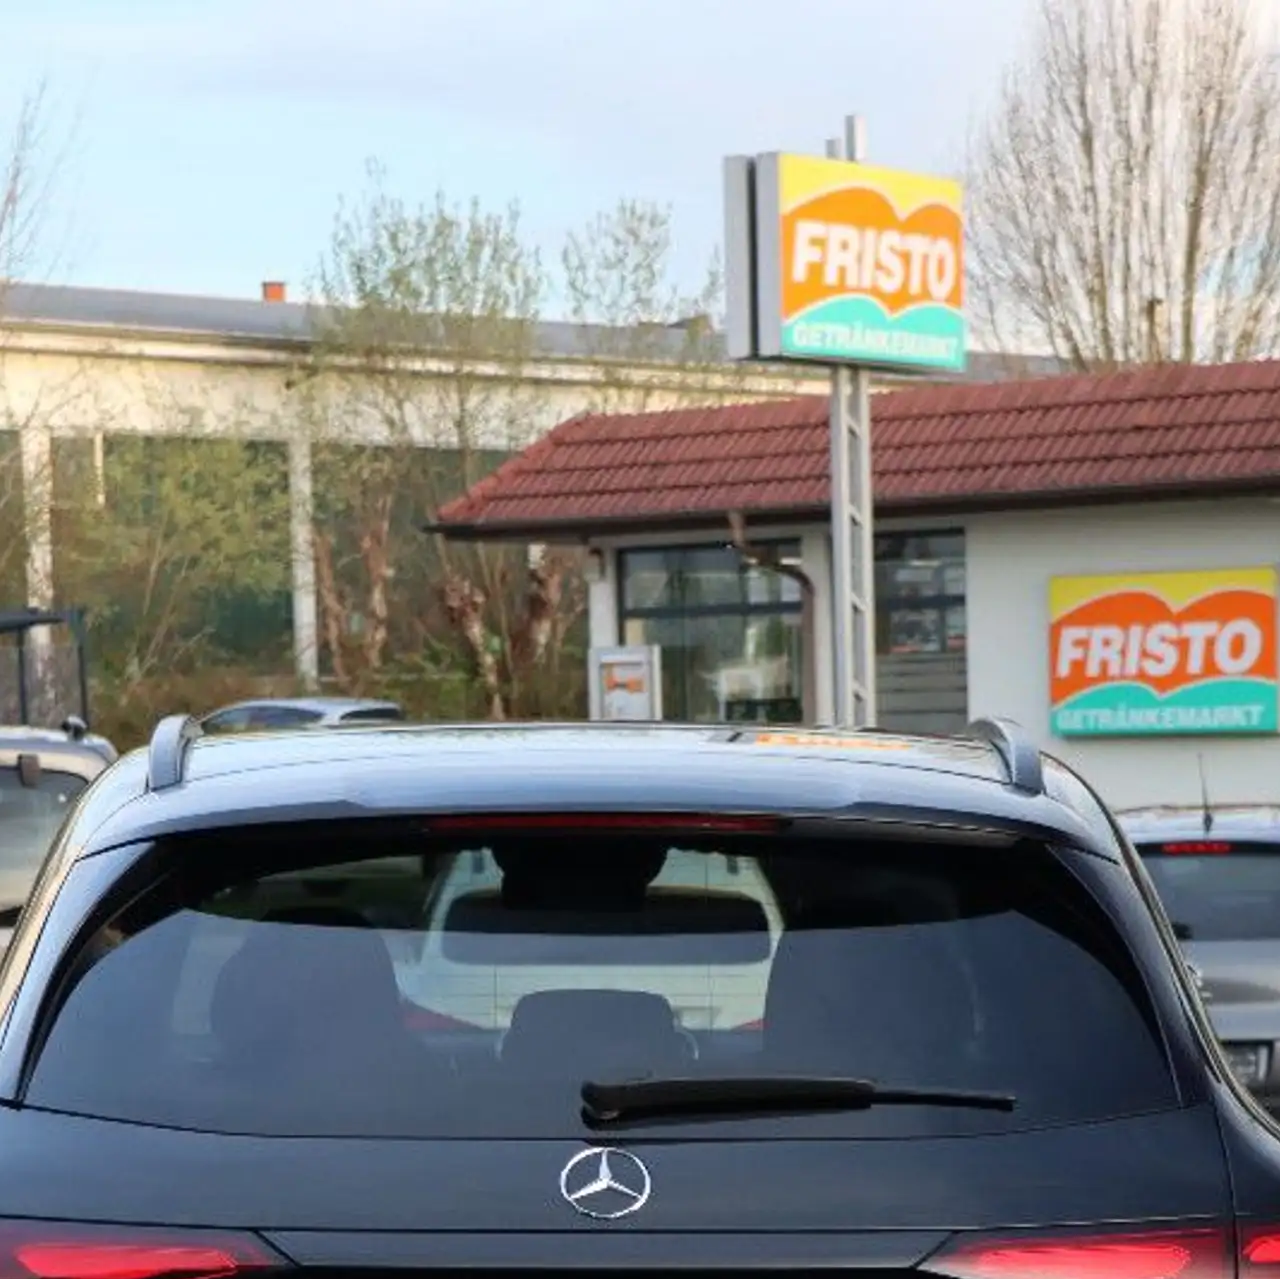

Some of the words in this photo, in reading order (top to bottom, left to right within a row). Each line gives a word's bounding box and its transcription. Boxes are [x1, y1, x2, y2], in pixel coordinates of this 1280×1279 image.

[792, 221, 956, 301] FRISTO
[1057, 618, 1262, 677] FRISTO
[1057, 704, 1263, 729] GETRÄNKEMARKT
